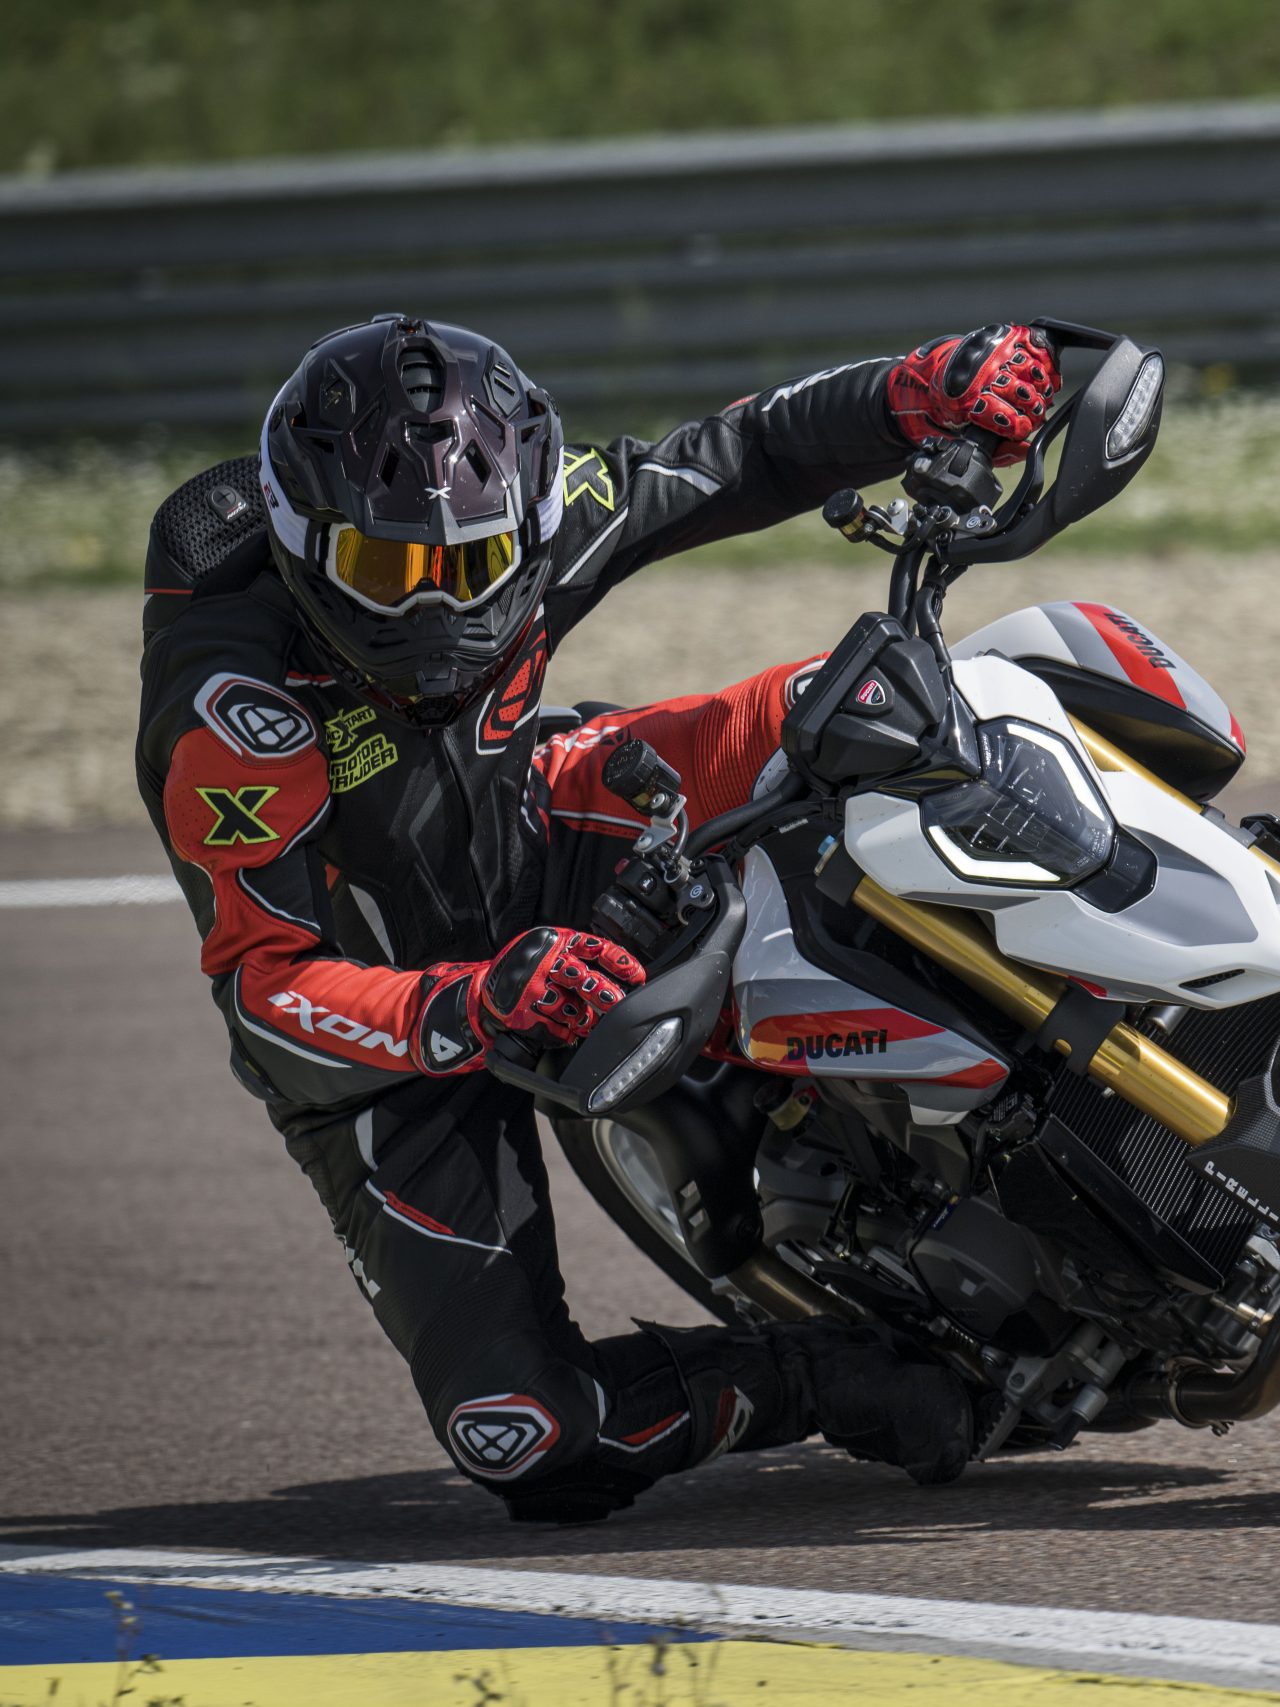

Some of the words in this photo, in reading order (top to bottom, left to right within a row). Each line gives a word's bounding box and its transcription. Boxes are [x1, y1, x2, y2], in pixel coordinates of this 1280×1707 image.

[1103, 612, 1177, 669] DUCATI
[786, 1029, 888, 1061] DUCATI
[1204, 1160, 1280, 1222] PIRELLI
